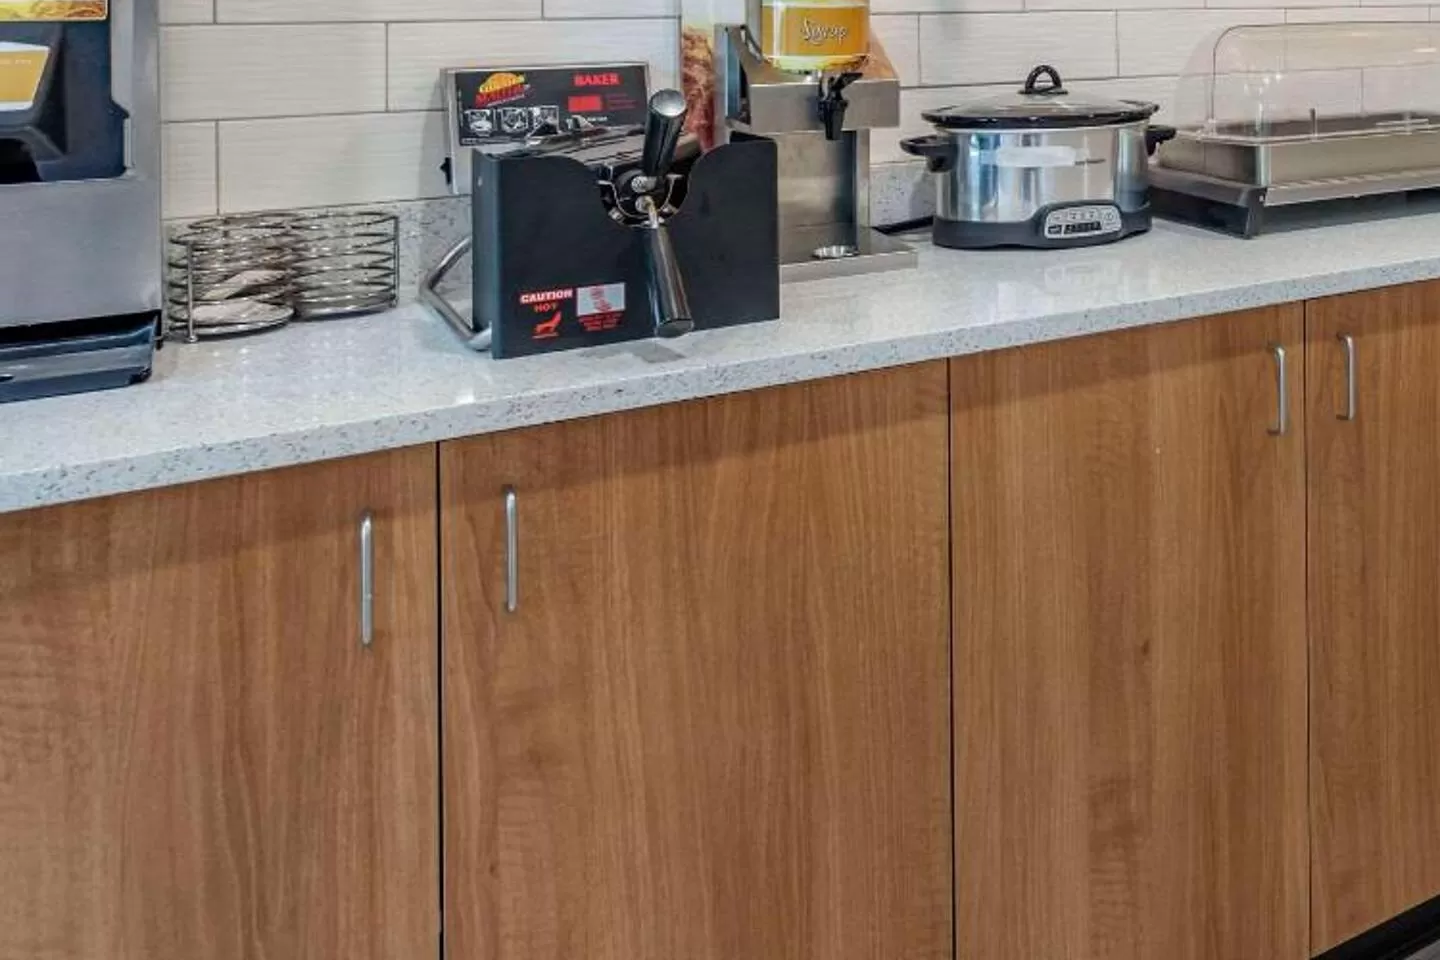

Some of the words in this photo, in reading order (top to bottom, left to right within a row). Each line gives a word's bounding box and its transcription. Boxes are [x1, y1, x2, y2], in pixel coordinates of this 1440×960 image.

[800, 17, 849, 46] Syrup
[573, 73, 620, 87] BAKER
[520, 287, 574, 304] CAUTION
[533, 301, 559, 313] HOT
